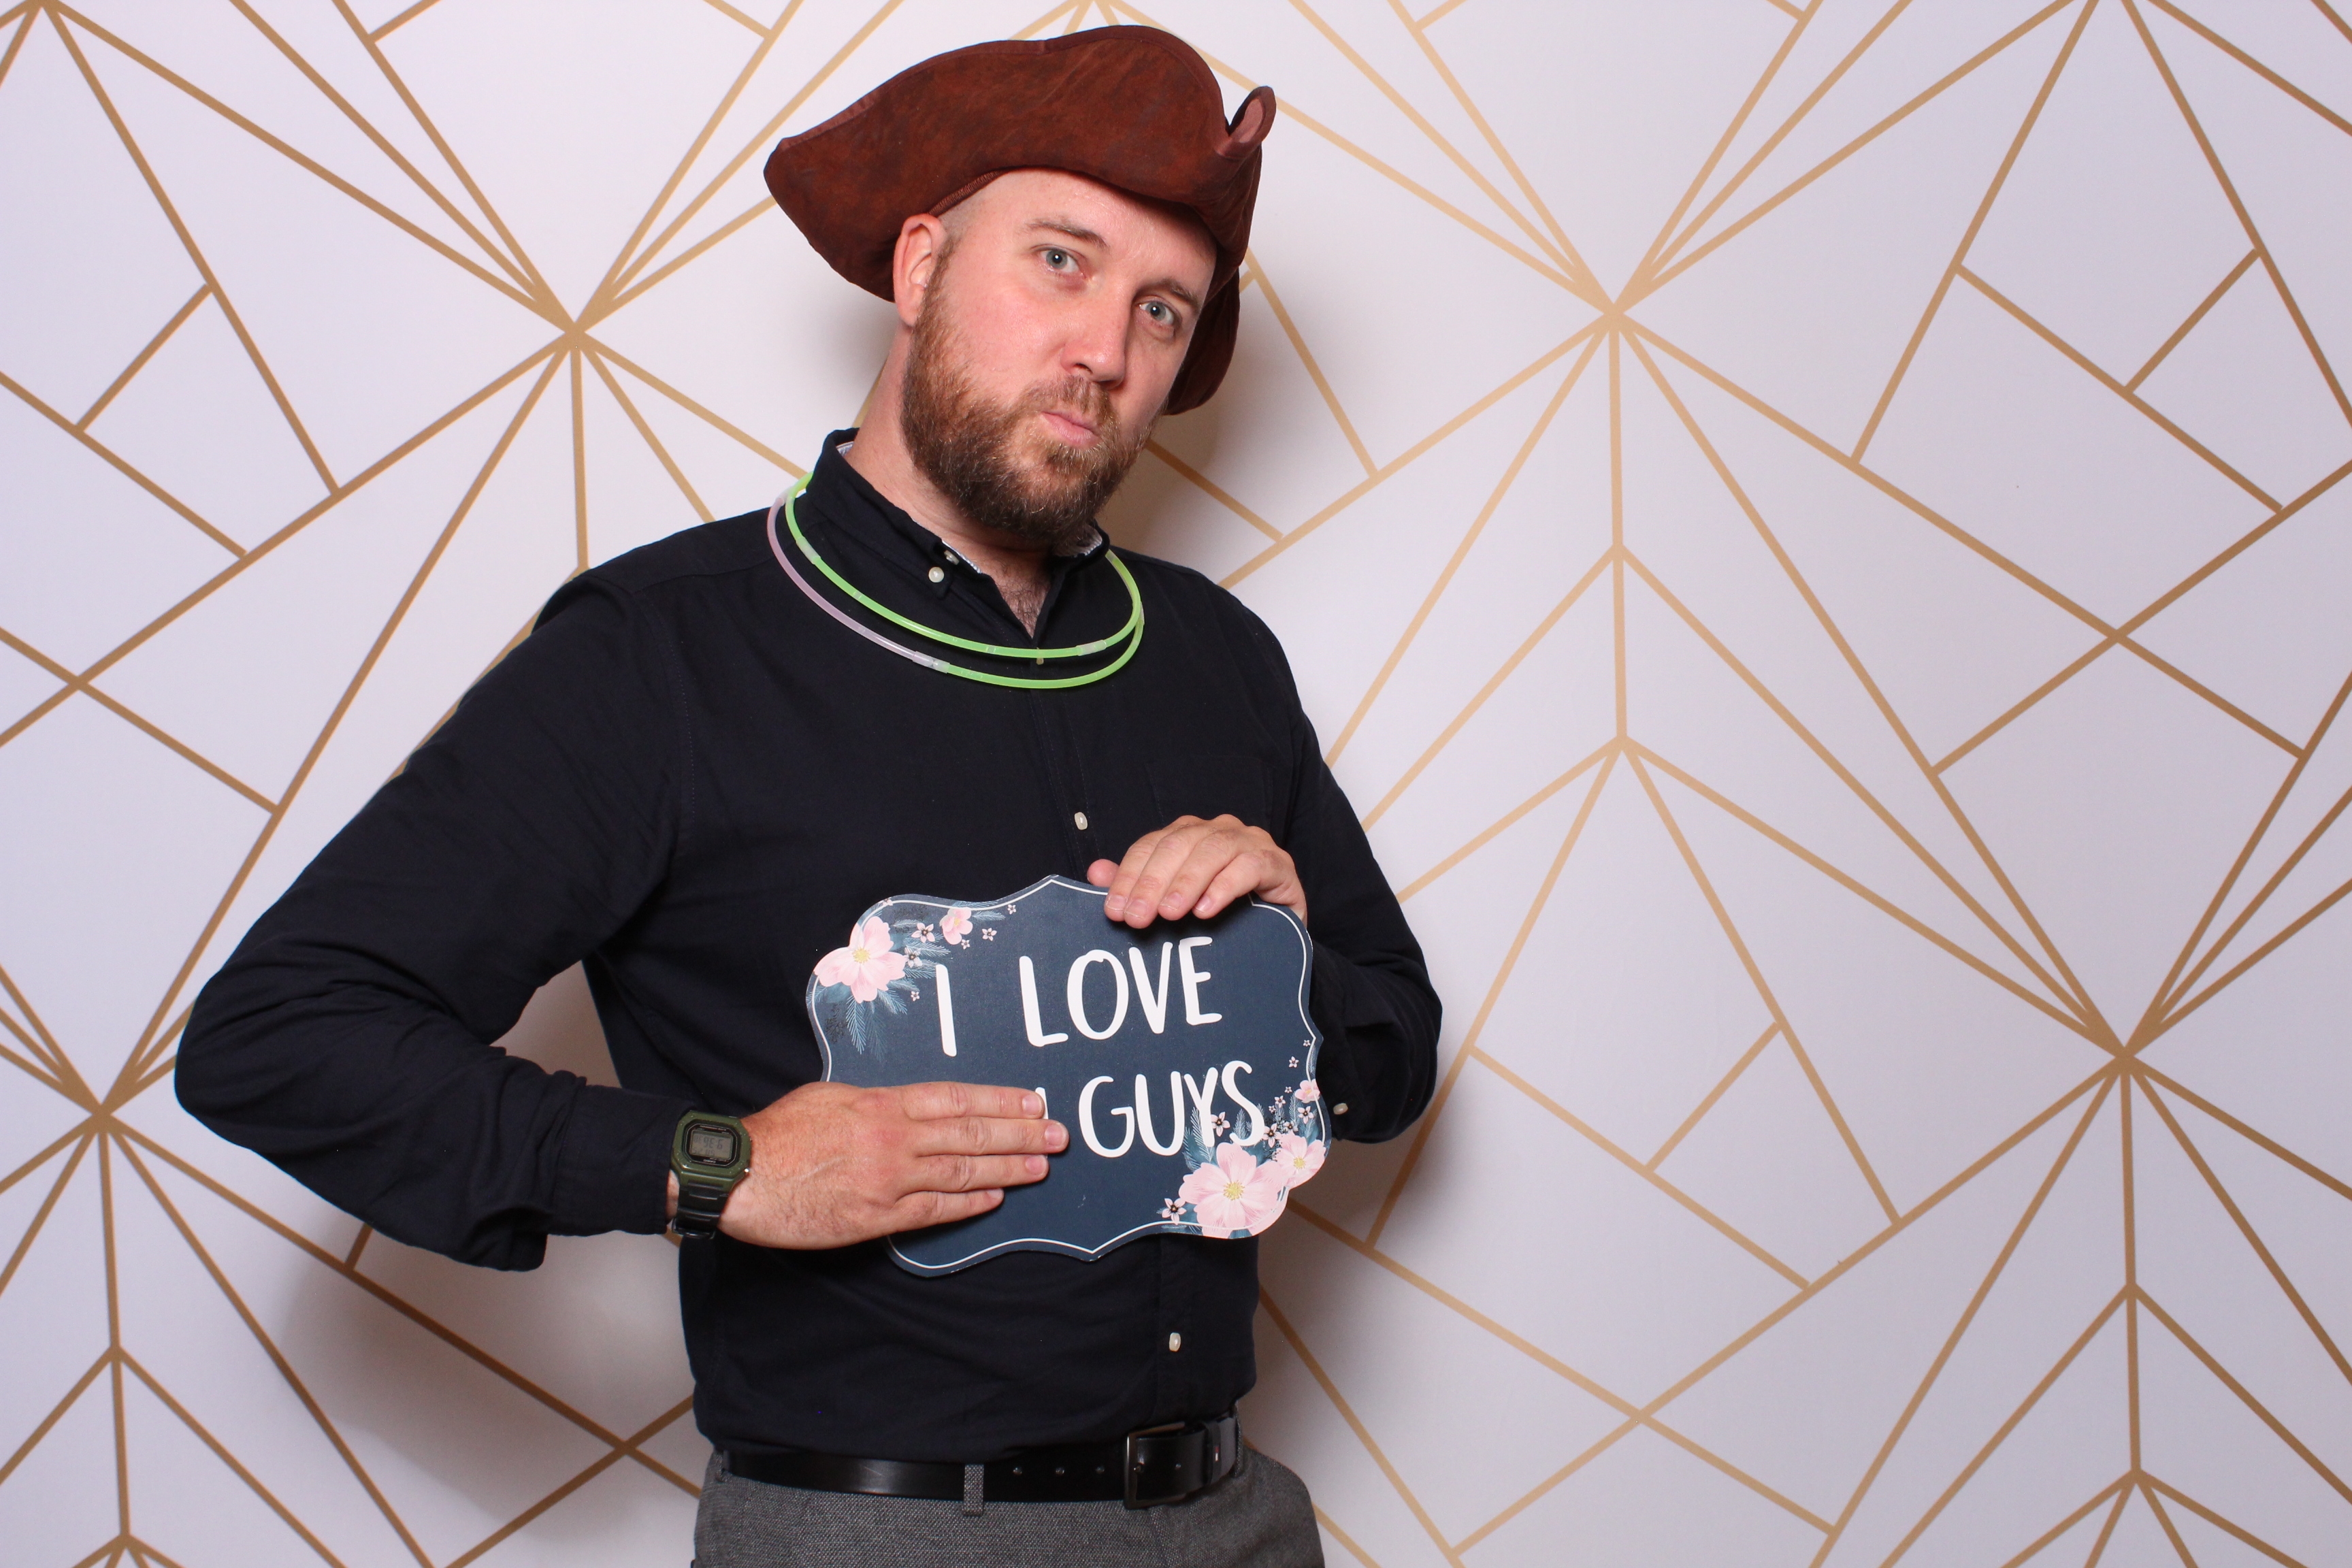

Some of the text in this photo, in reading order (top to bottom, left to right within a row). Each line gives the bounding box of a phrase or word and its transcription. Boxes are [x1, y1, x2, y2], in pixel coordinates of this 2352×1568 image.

[936, 936, 1222, 1057] I LOVE
[1079, 1060, 1266, 1158] GUYS
